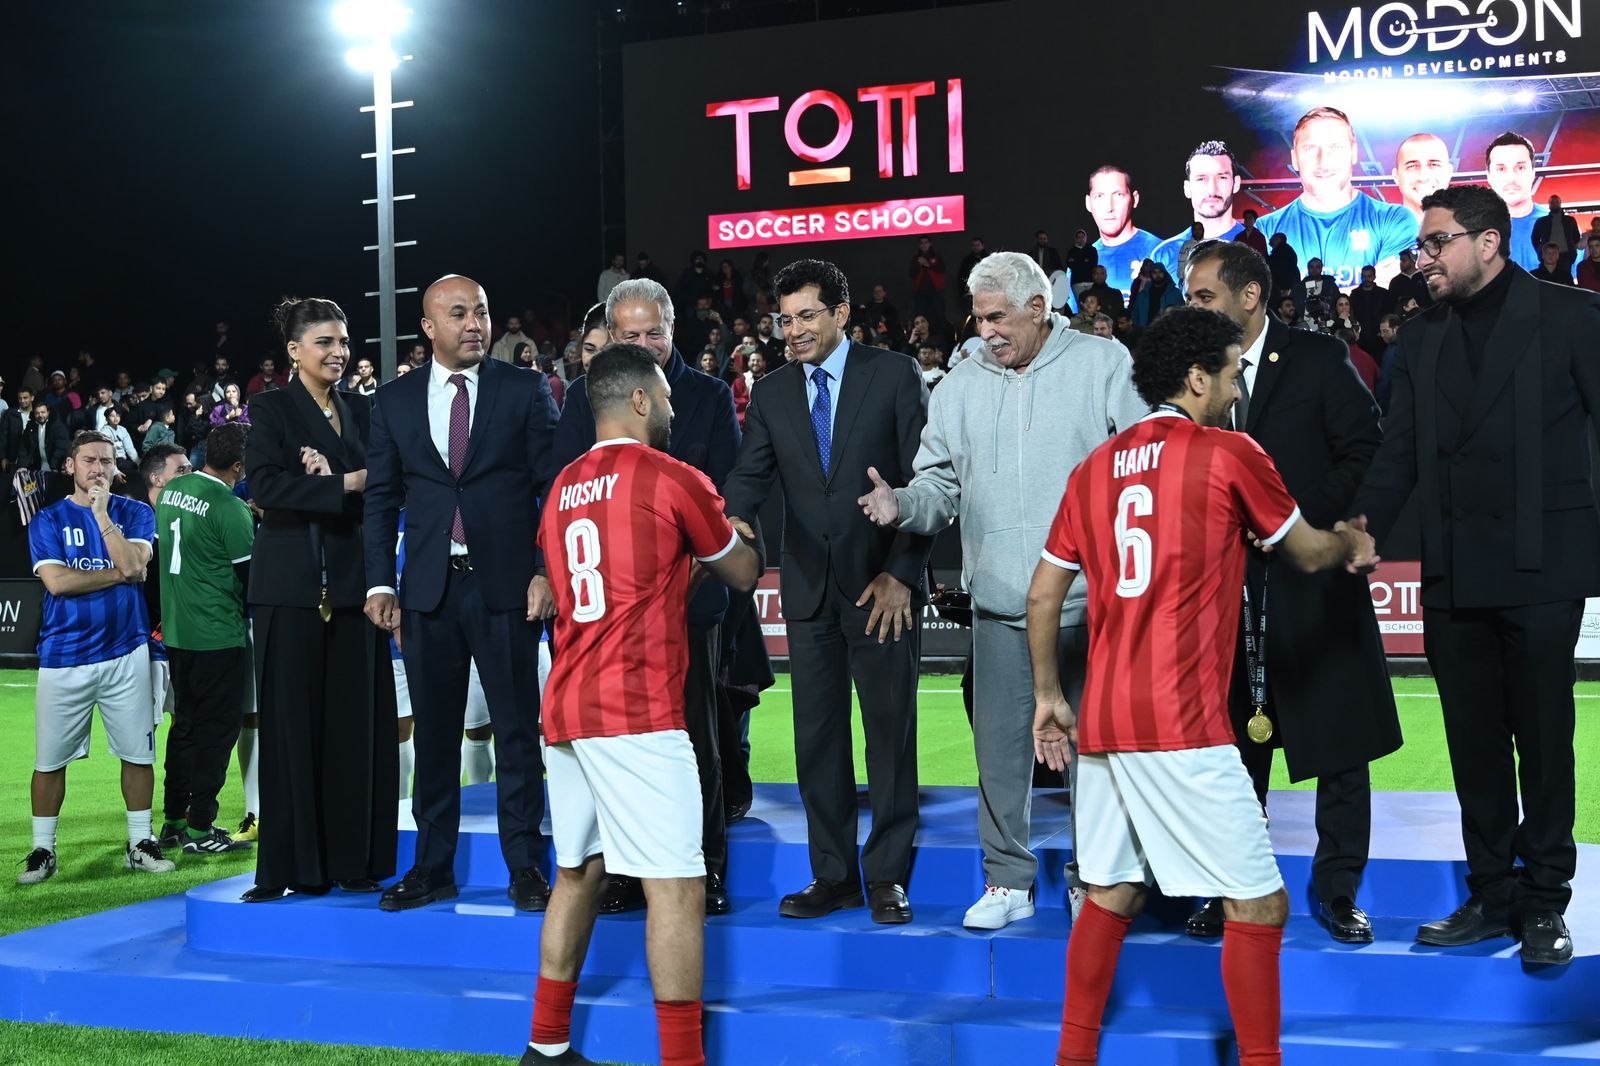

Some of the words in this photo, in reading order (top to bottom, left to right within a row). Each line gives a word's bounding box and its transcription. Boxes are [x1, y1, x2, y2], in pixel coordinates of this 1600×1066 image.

[1307, 0, 1582, 63] MODON
[1324, 66, 1393, 83] MODON
[1403, 51, 1567, 76] DEVELOPMENTS
[706, 78, 964, 190] TOTTI
[718, 213, 826, 241] SOCCER
[834, 205, 952, 234] SCHOOL
[1113, 440, 1166, 479] HANY
[180, 494, 210, 518] CESAR
[558, 473, 620, 512] HOSNY
[62, 526, 85, 547] 10
[169, 517, 182, 575] 1
[1114, 484, 1153, 598] 6
[565, 518, 606, 623] 8
[1369, 581, 1422, 615] OTT
[922, 621, 960, 630] MODON
[1384, 623, 1423, 631] SCHOO
